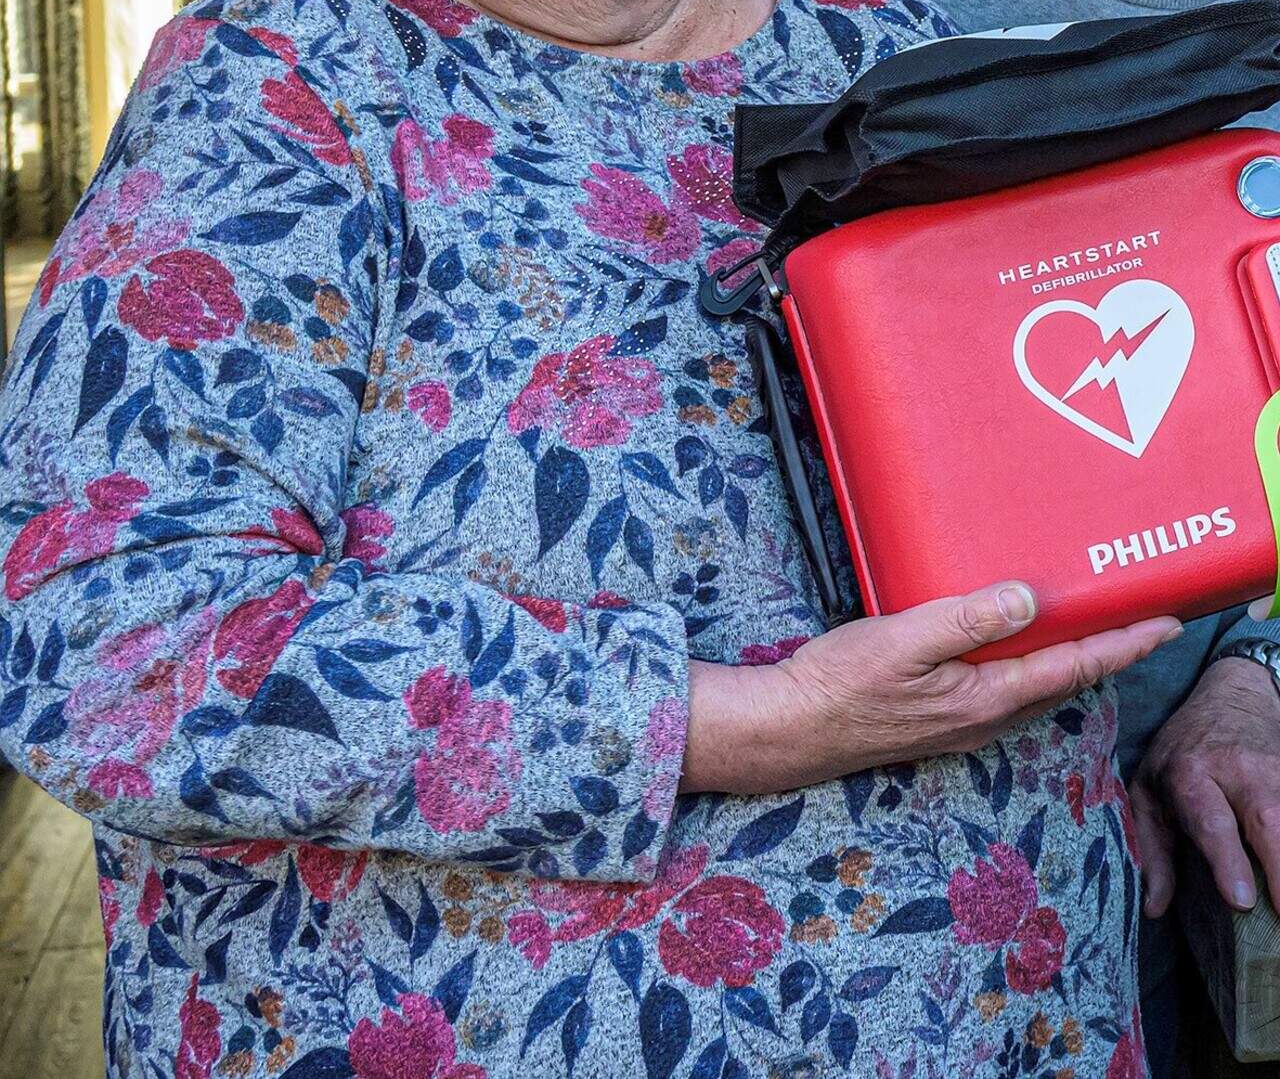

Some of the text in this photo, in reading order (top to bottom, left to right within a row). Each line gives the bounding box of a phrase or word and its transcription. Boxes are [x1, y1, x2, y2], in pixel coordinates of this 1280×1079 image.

[998, 231, 1161, 285] HEARTSTART
[1032, 257, 1143, 295] DEFIBRILLATOR
[1087, 506, 1237, 575] PHILIPS
